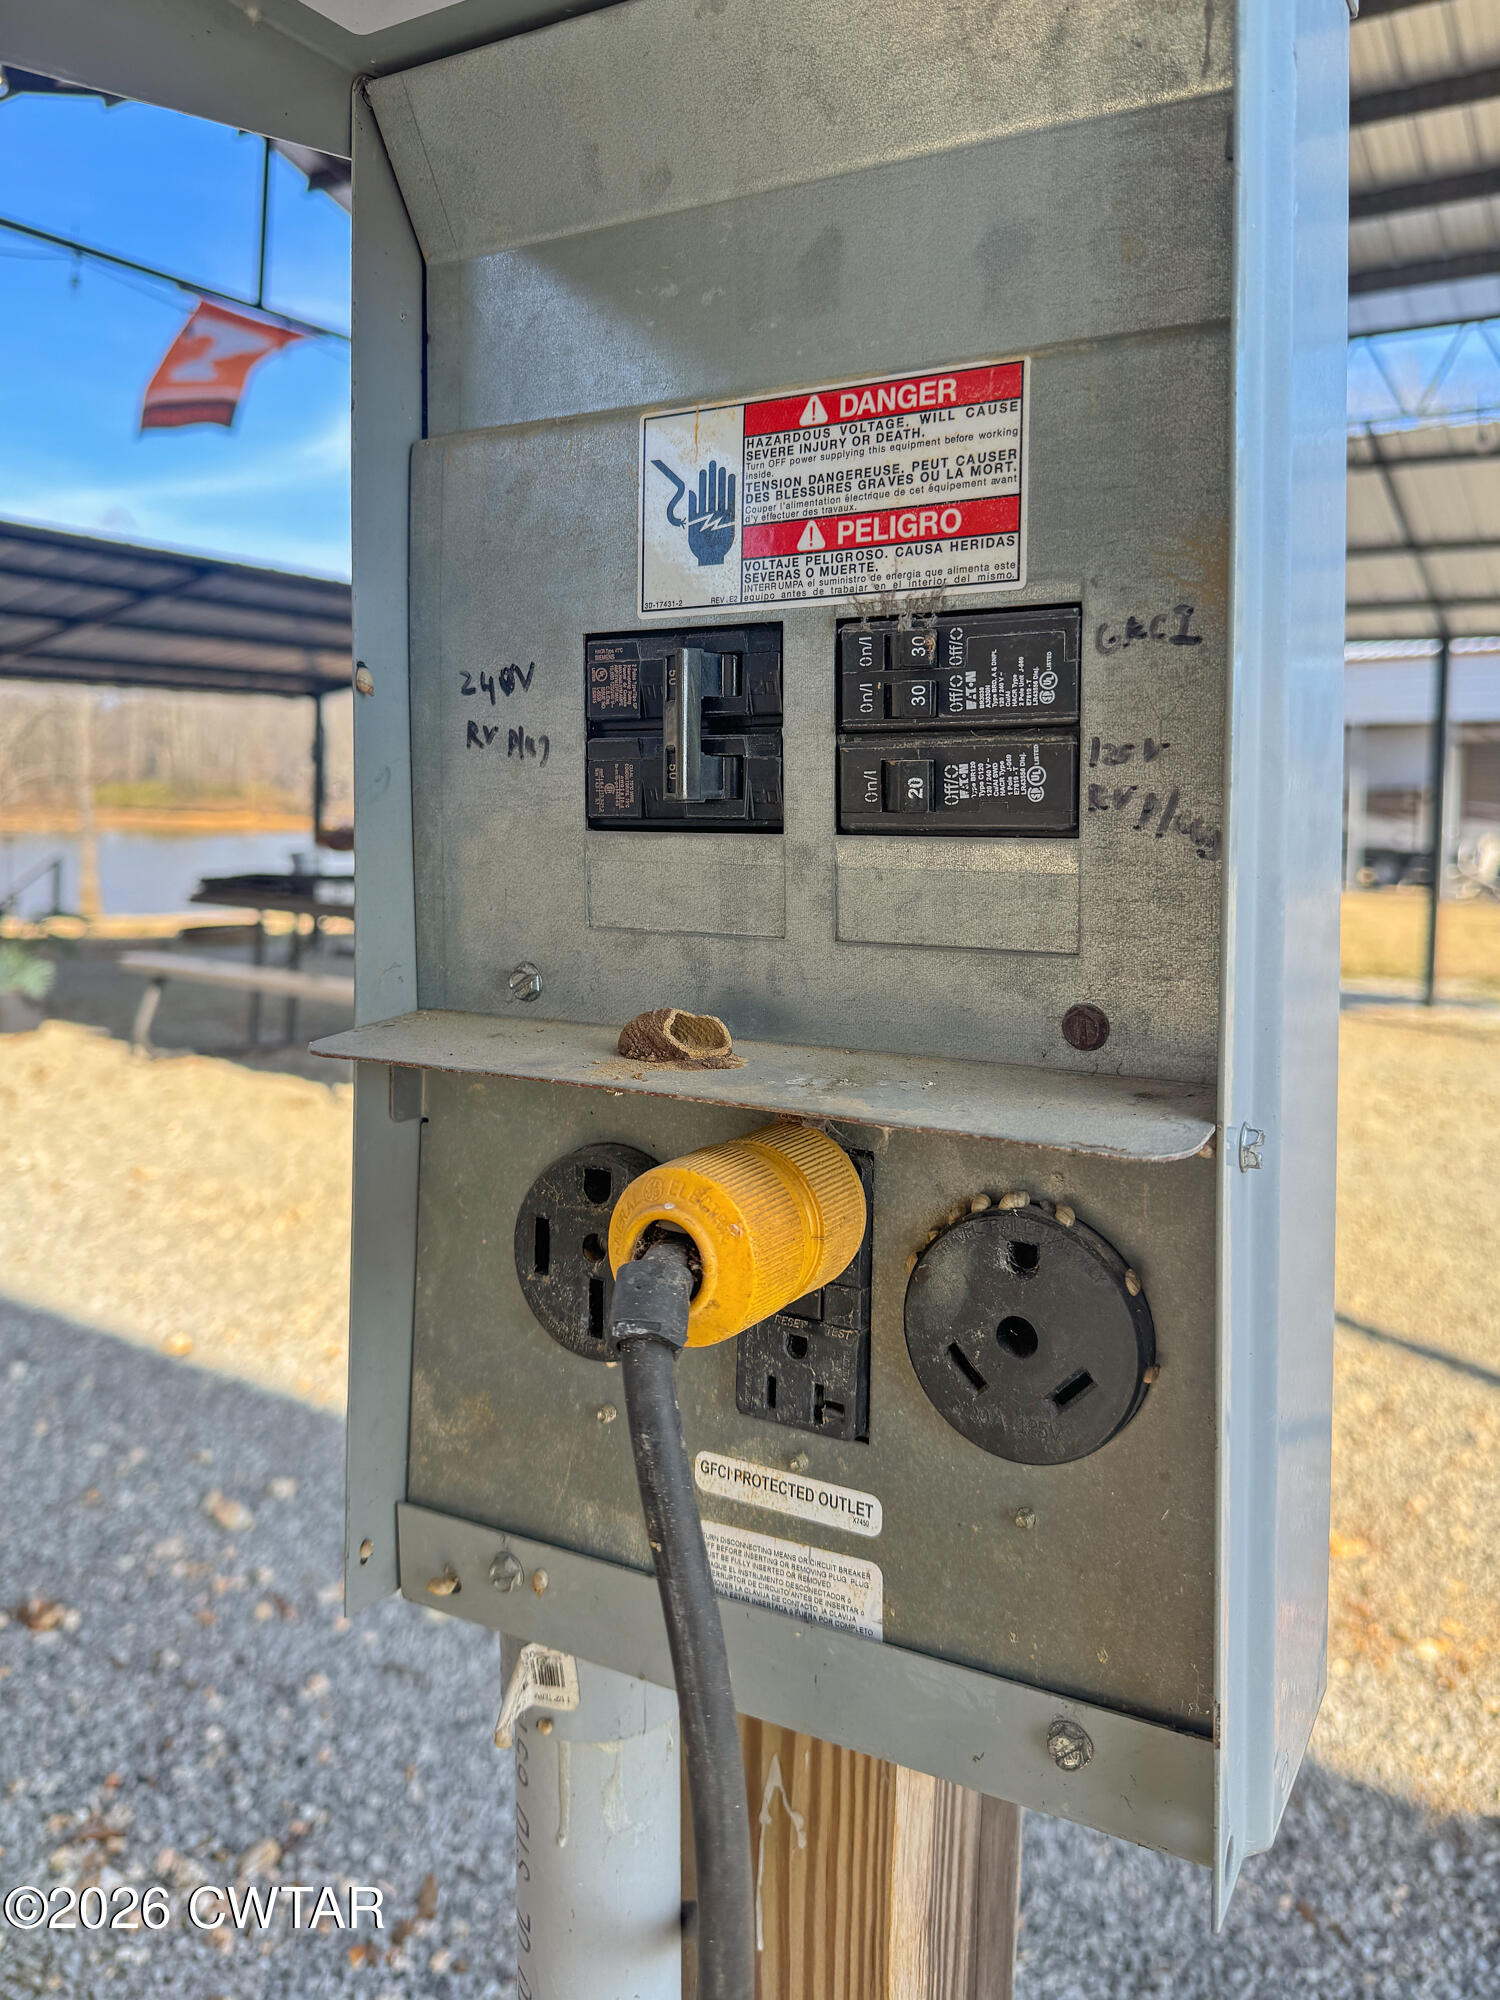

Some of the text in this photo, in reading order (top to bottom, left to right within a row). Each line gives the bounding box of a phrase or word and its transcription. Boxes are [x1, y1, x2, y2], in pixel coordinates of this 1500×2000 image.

[840, 378, 957, 418] DANGER
[747, 401, 1018, 449] HAZARDOUS VOLTAGE. WILL CAUSE
[746, 427, 925, 461] SEVERE INJURY OR DEATH.
[746, 428, 1018, 471] Turn OFF power supplying this equipment before working
[746, 448, 1017, 493] TENSION DANGEREUSE. PEUT CAUSER
[746, 470, 774, 480] inside.
[746, 462, 1017, 504] DES BLESSURES GRAVES OU LA MORT.
[745, 475, 1017, 515] Couper l'alimentation électrique de cet équipement avant
[745, 504, 857, 524] d'y effectuer des travaux.
[837, 508, 962, 545] PELIGRO
[744, 535, 1015, 572] VOLTAJE PELIGROSO. CAUSA HERIDAS
[744, 562, 878, 584] SEVERAS O MUERTE.
[744, 572, 1015, 602] equipo antes de trabajar en el interior del mismo.
[807, 578, 815, 587] el
[819, 575, 866, 586] suministro
[870, 572, 881, 582] de
[925, 568, 943, 578] que
[947, 564, 989, 575] alimenta
[994, 561, 1016, 570] este
[911, 636, 926, 657] 30
[911, 685, 926, 706] 30
[466, 719, 499, 750] RV
[907, 777, 923, 799] 20
[700, 1459, 873, 1518] GFCI PROTECTED OUTLET
[716, 1544, 743, 1557] BEFORE
[744, 1552, 778, 1566] INSERTING
[779, 1561, 789, 1569] OR
[791, 1563, 827, 1578] REMOVING
[720, 1536, 871, 1580] DISCONNECTING MEANS OR CIRCUIT BREAKER
[731, 1556, 750, 1567] FULLY
[752, 1562, 785, 1576] INSERTED
[785, 1570, 796, 1580] OR
[797, 1574, 831, 1588] REMOVED
[729, 1565, 846, 1602] EL INSTRUMENTO DESCONECTADOR
[747, 1580, 859, 1615] DE CIRCUITO ANTES DE INSERTAR
[735, 1585, 743, 1593] LA
[744, 1586, 770, 1600] CLAVIJA
[771, 1594, 780, 1603] DE
[828, 1609, 857, 1624] CLAVIJA
